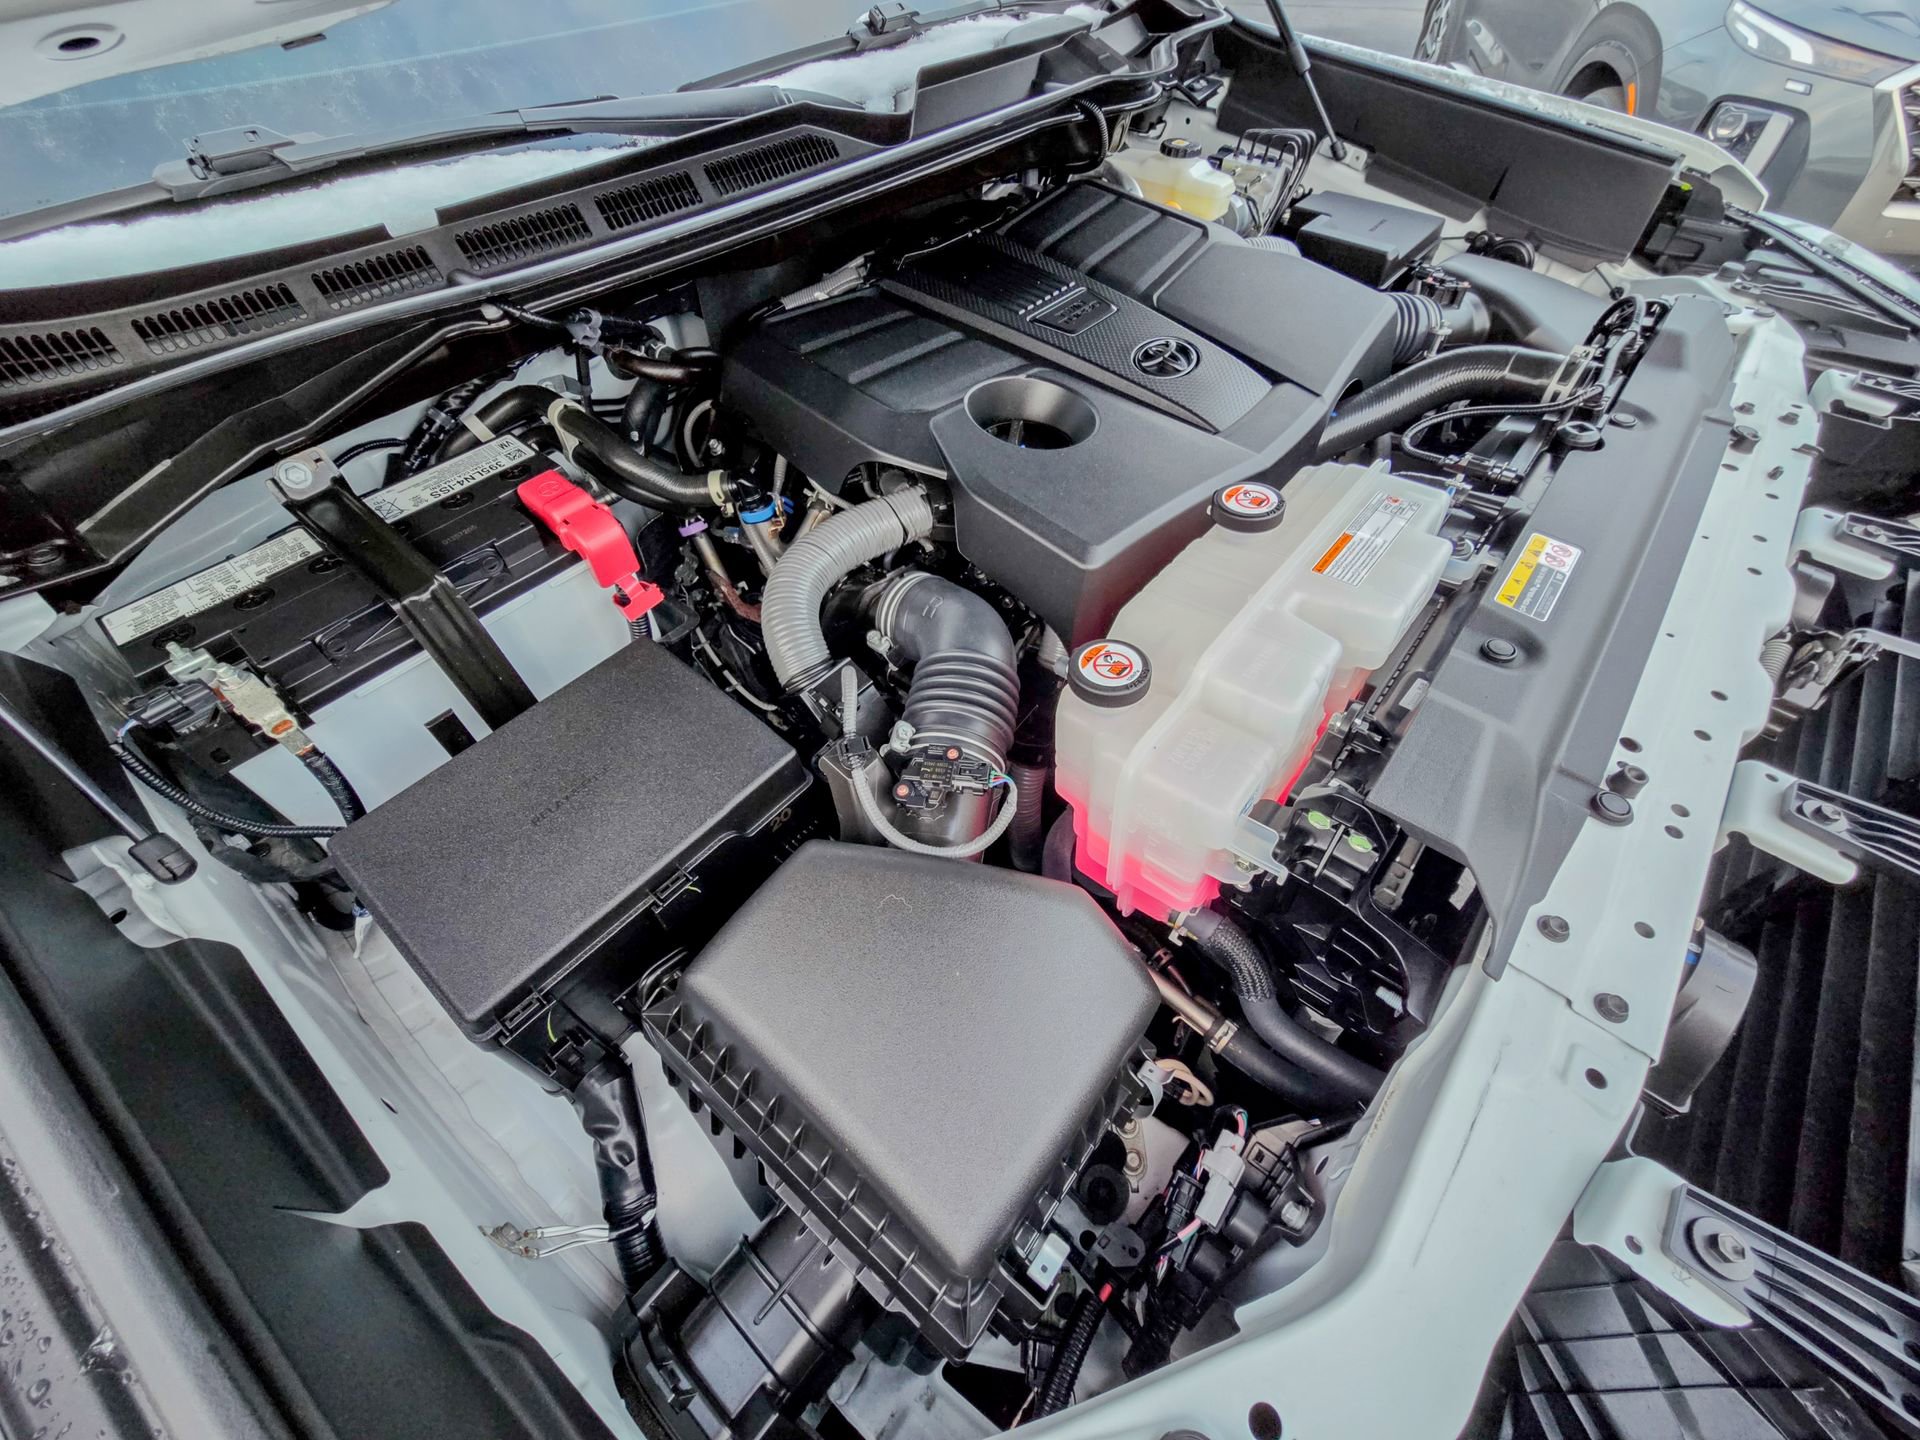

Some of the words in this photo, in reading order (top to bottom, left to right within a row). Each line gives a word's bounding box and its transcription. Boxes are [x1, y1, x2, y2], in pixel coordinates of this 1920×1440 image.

[498, 440, 514, 450] VM
[430, 461, 506, 499] 395LN4-ISS
[770, 807, 792, 832] 20
